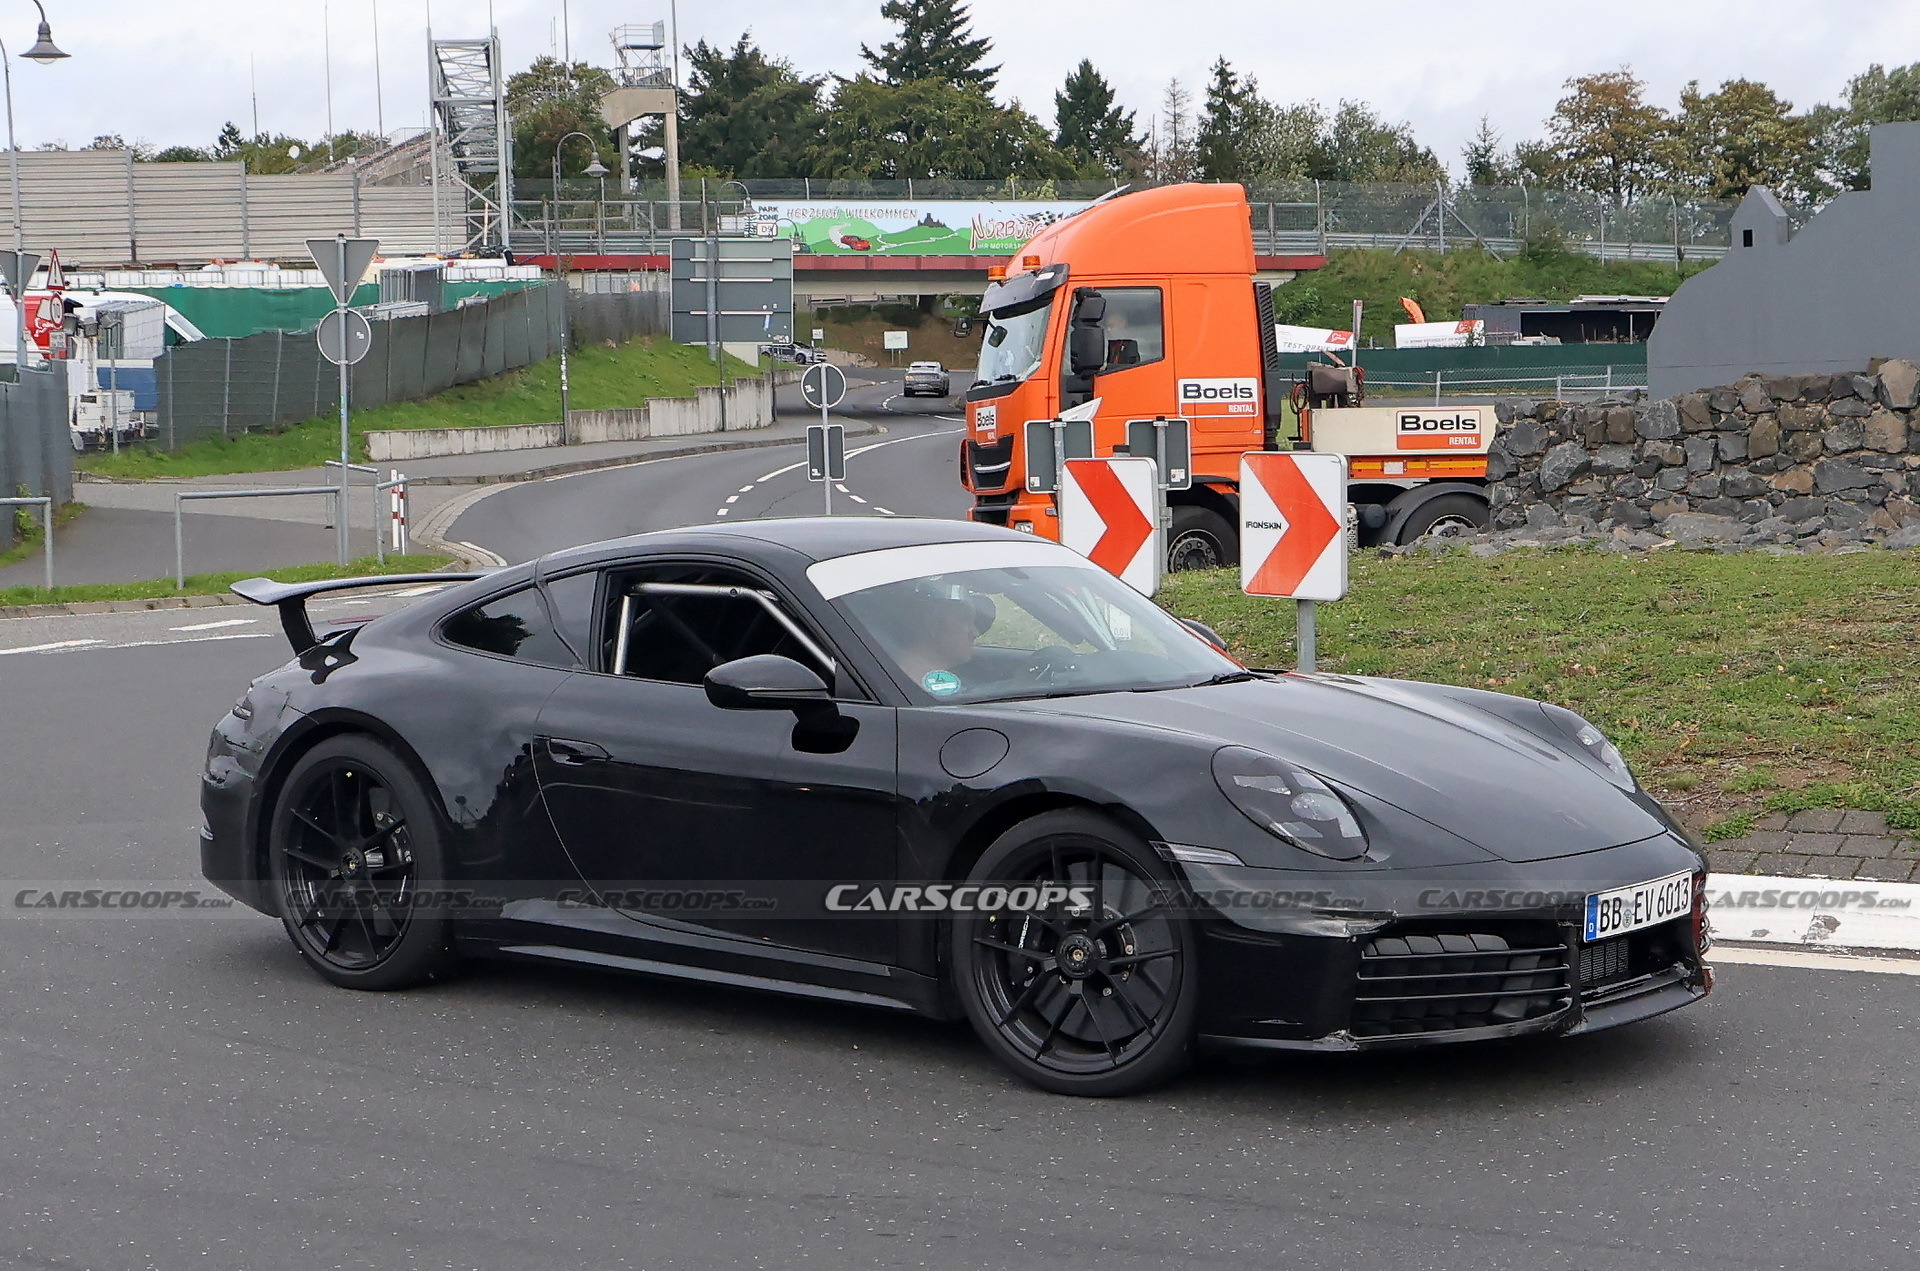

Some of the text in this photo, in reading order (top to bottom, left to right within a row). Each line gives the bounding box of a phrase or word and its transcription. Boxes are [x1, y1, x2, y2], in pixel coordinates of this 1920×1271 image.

[787, 208, 918, 219] HERZLICH WILLKOMMEN
[1183, 383, 1253, 399] Boels
[1228, 404, 1254, 413] RENTAL
[977, 411, 995, 427] Boels
[1401, 414, 1477, 431] Boels
[1448, 436, 1477, 445] RENTAL
[1245, 520, 1282, 530] IRONSKIN
[1600, 897, 1622, 932] BB
[1633, 888, 1654, 925] EV
[1657, 877, 1690, 918] 6013
